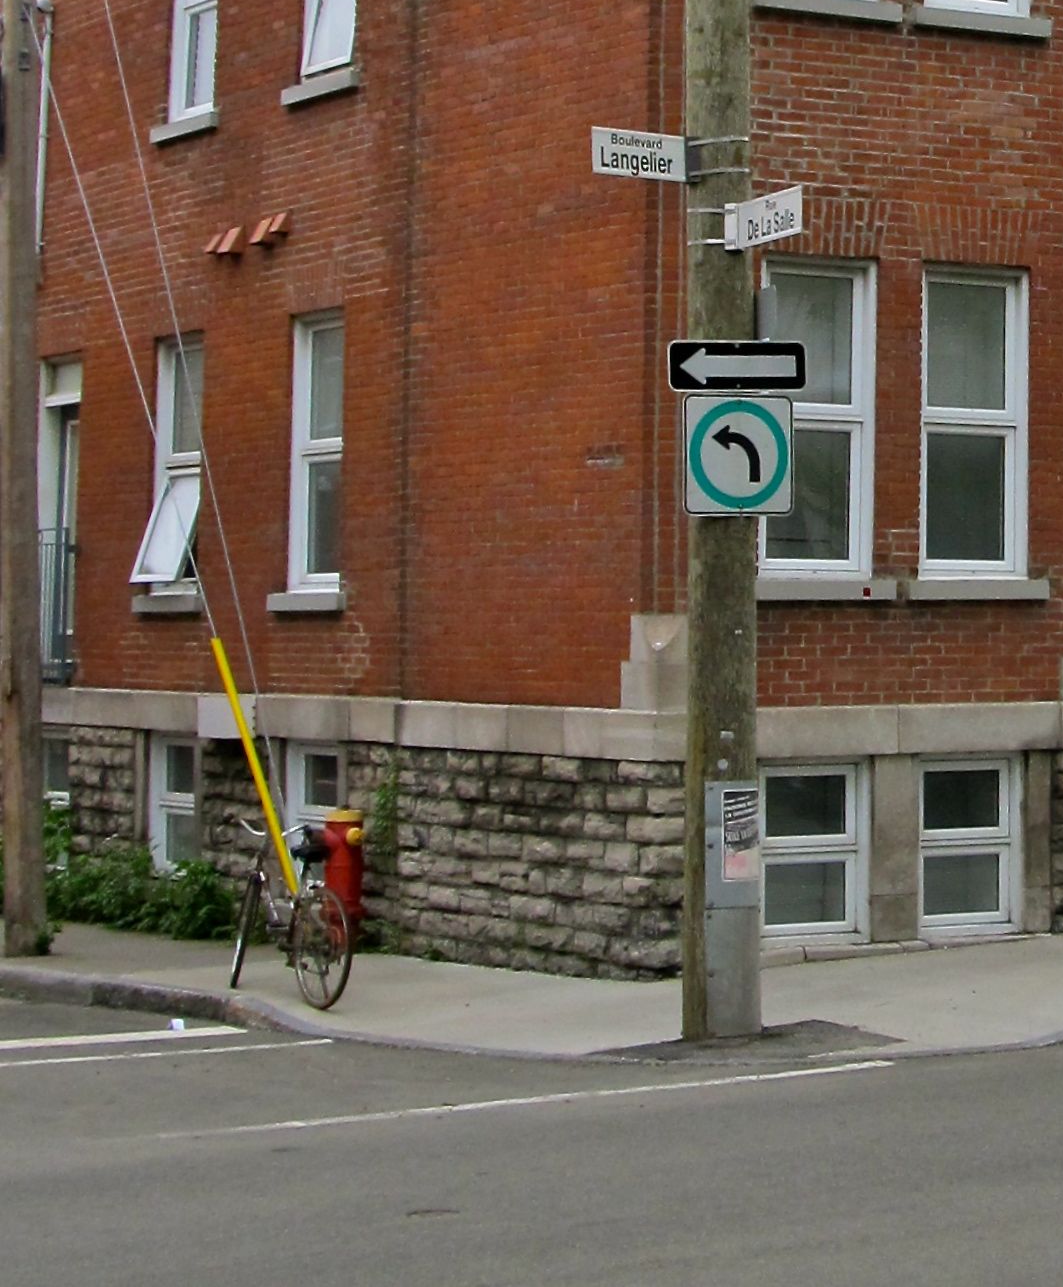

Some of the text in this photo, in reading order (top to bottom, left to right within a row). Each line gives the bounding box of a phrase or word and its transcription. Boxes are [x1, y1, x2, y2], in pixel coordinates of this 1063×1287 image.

[611, 133, 662, 150] Boulevard
[601, 146, 672, 175] Langelier
[765, 200, 777, 210] Rue
[747, 209, 795, 240] De La Salle
